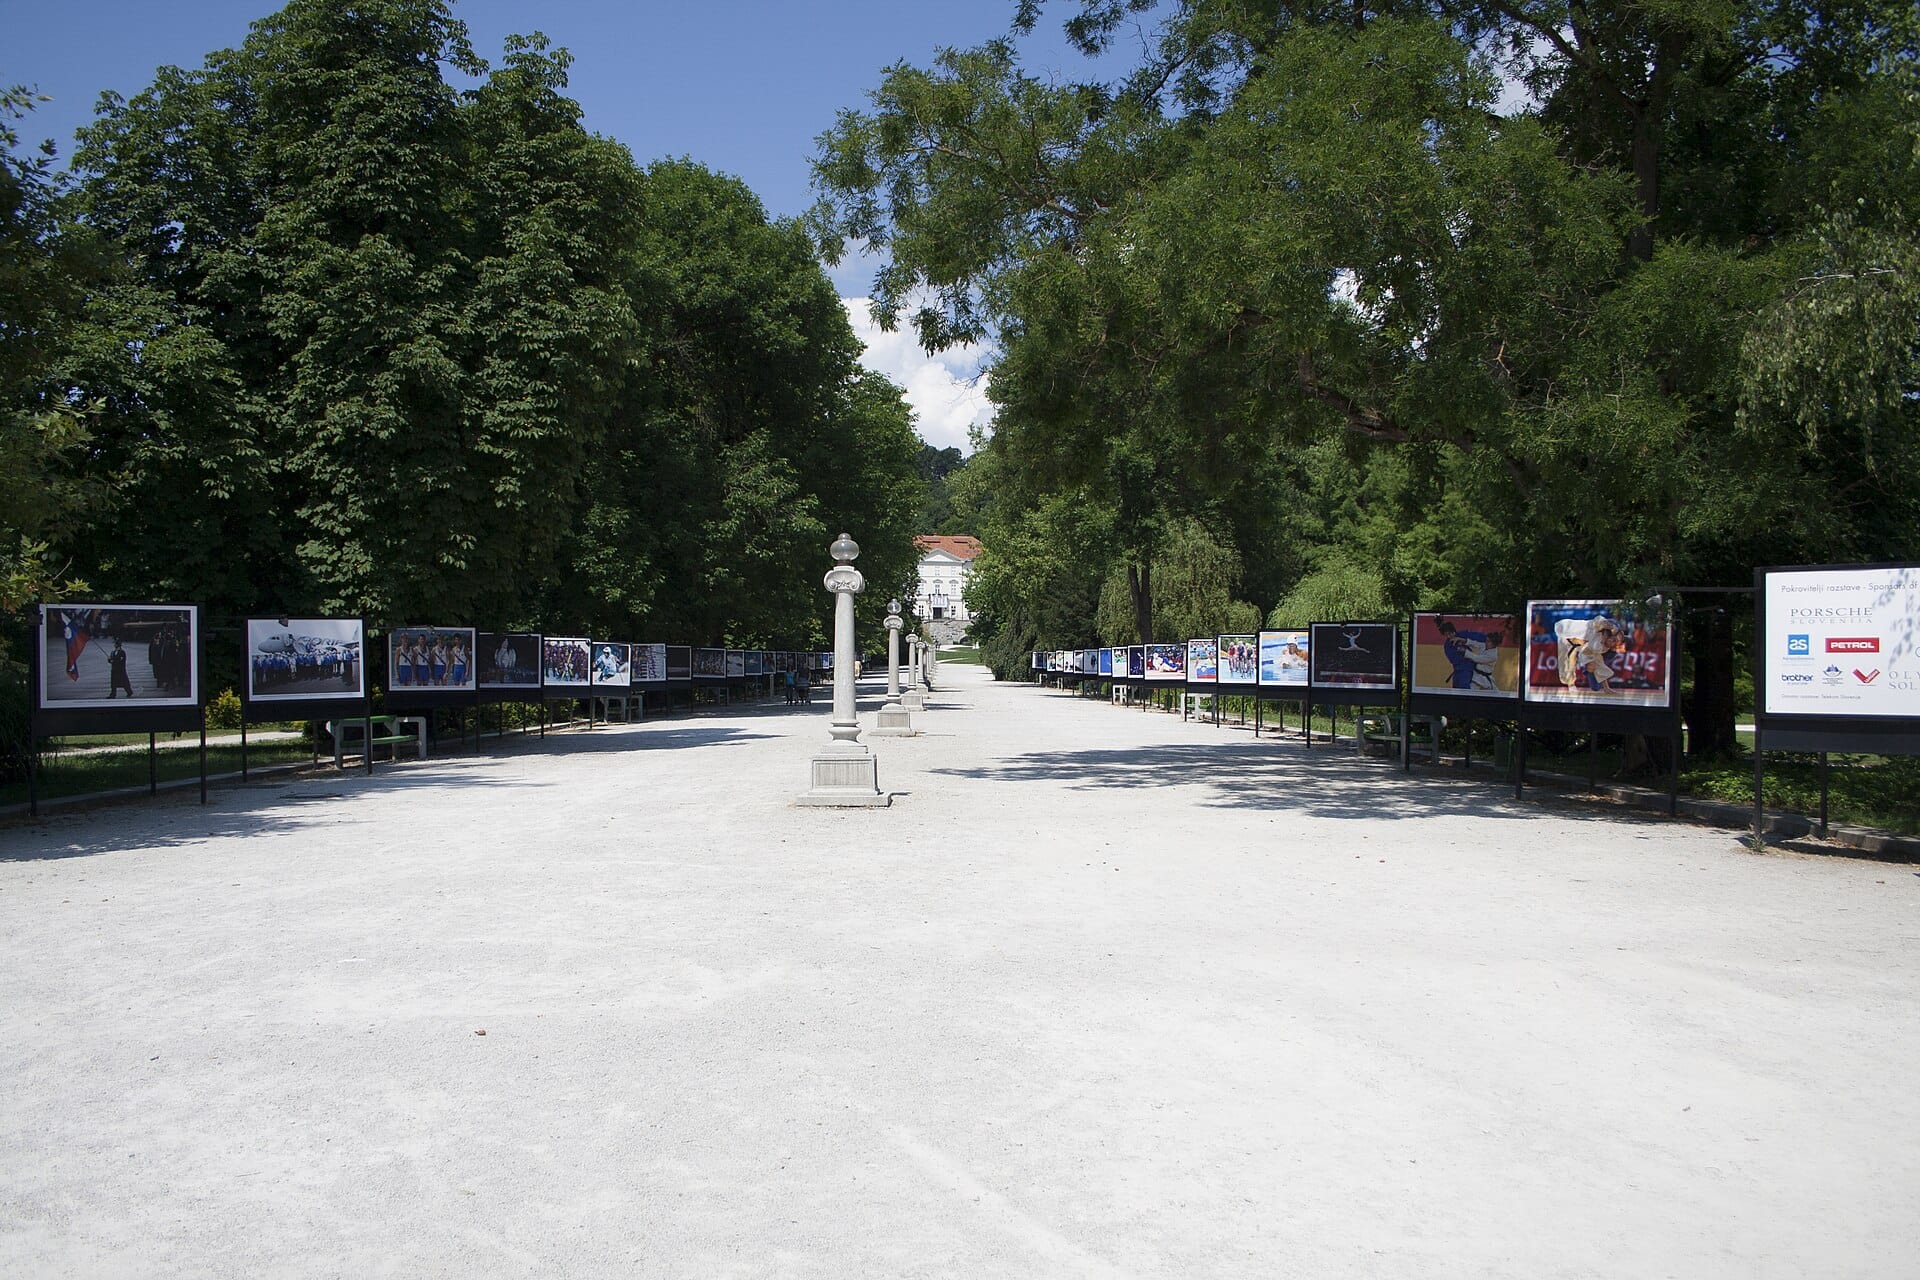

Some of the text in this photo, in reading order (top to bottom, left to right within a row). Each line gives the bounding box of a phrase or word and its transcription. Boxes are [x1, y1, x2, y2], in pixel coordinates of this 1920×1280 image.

[1781, 585, 1824, 593] Pokrovitelji
[1827, 584, 1861, 592] razstave
[1790, 607, 1873, 617] PORSCHE
[1790, 617, 1873, 625] SLOVENIJA
[1830, 641, 1875, 649] PETROL
[1781, 673, 1814, 682] brother
